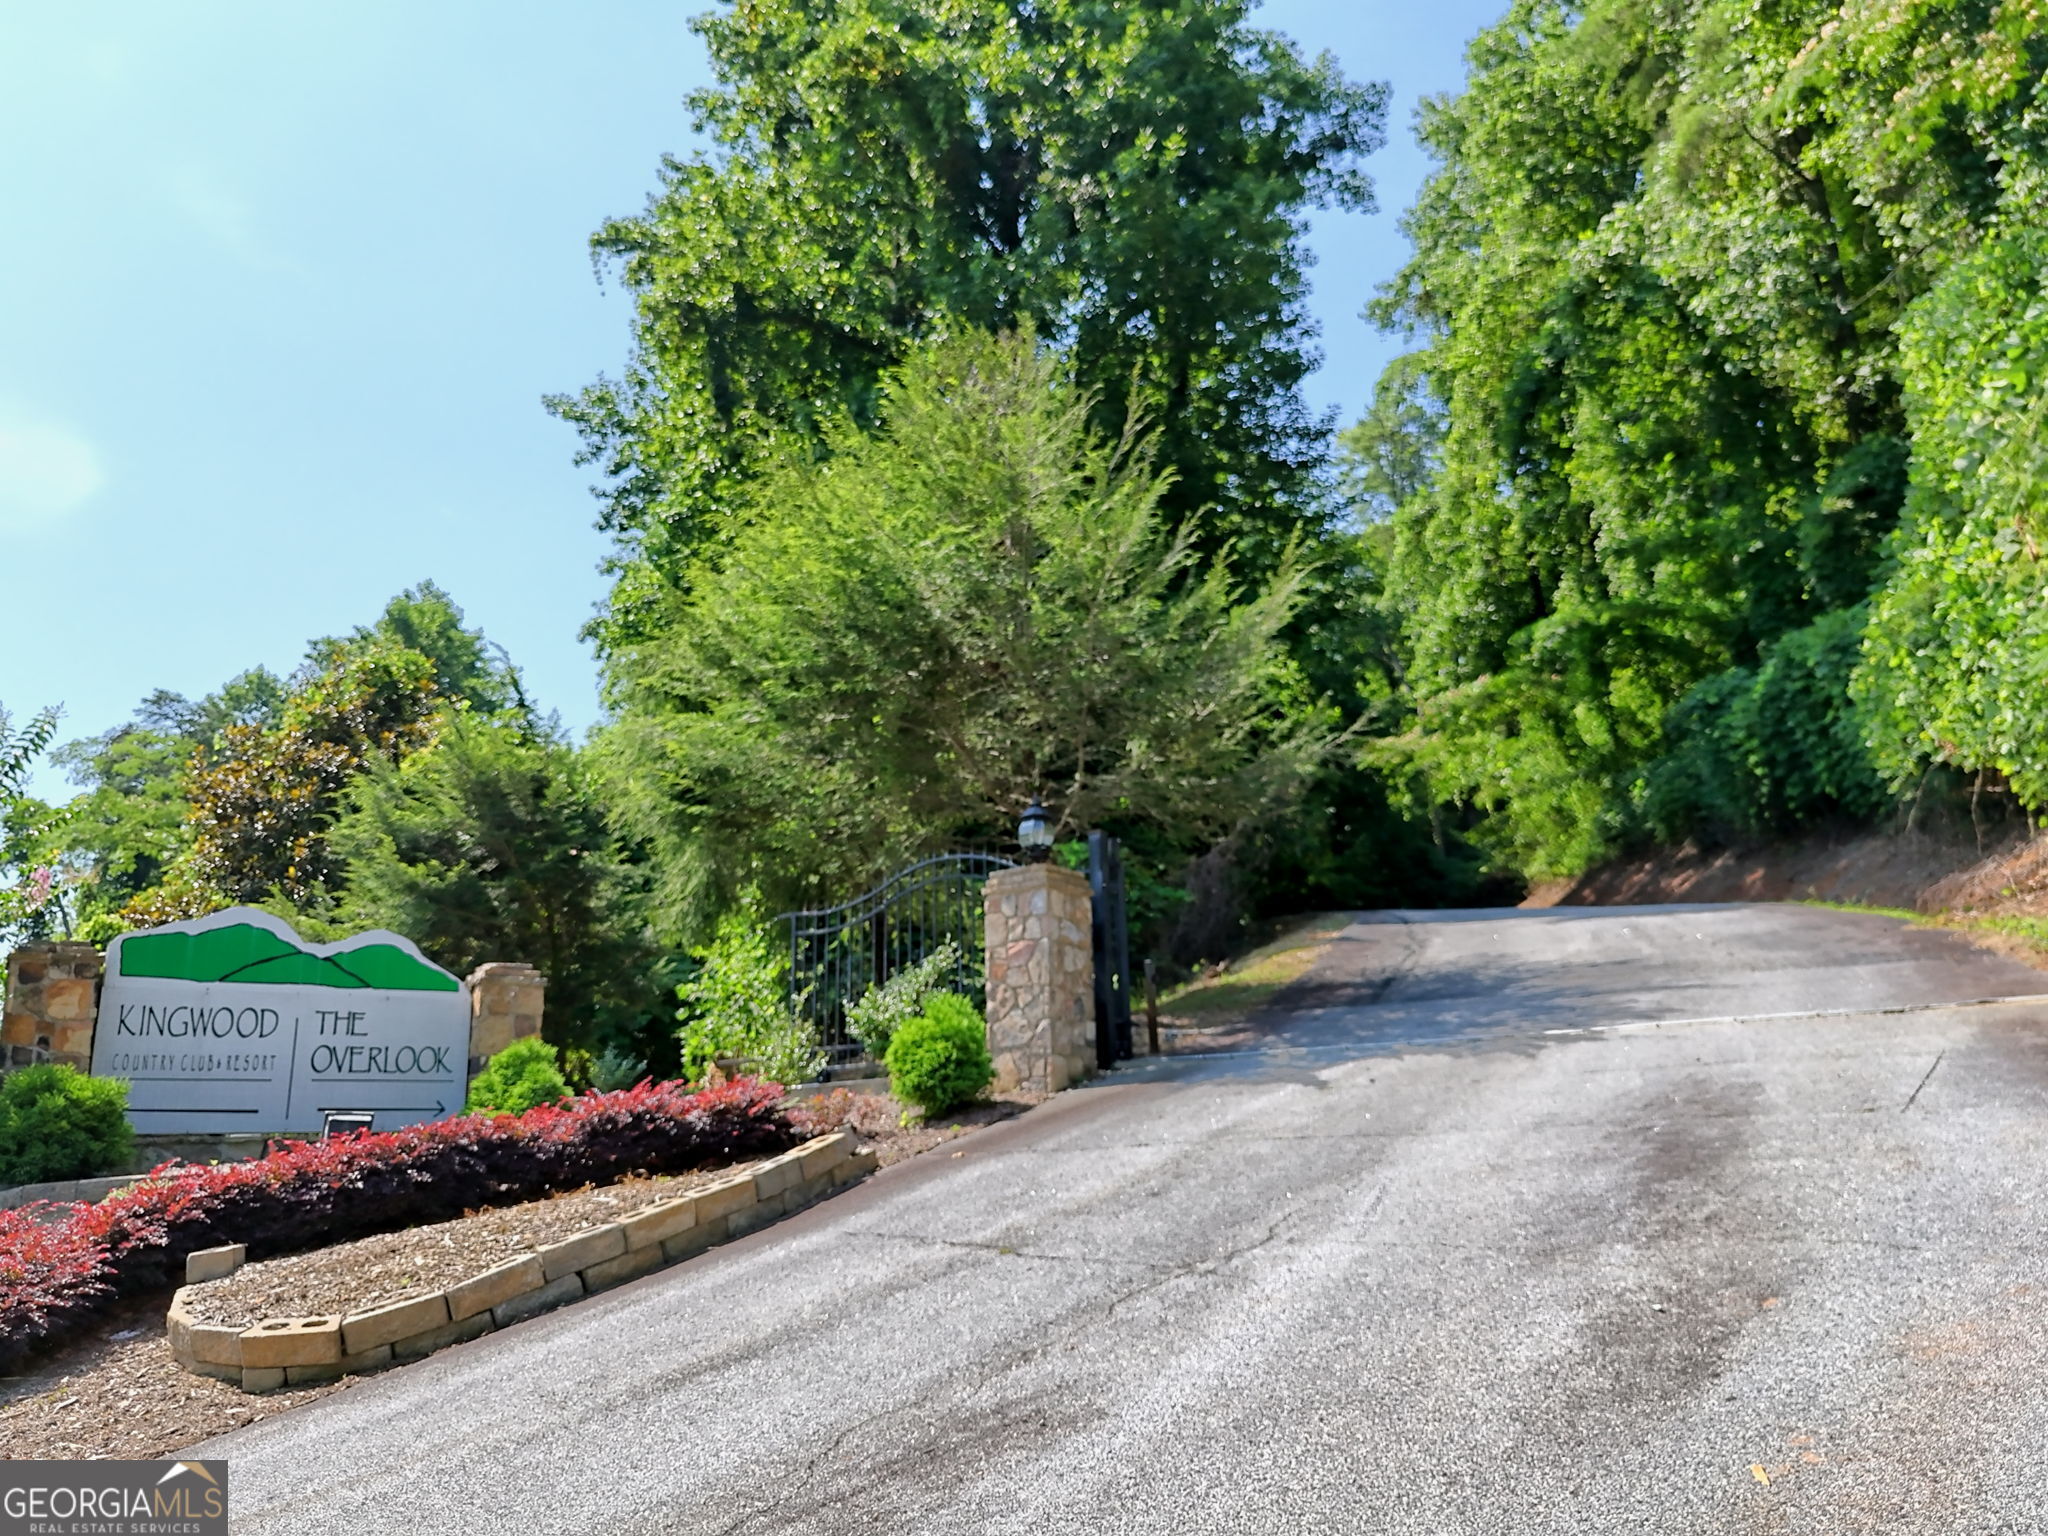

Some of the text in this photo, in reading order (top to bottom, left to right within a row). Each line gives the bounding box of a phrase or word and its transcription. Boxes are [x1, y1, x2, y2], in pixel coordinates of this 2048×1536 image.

[117, 1004, 279, 1038] KINGWOOD
[315, 1010, 368, 1037] THE
[112, 1053, 174, 1072] COUNTRY
[225, 1054, 277, 1073] RESORT
[310, 1045, 453, 1074] OVERLOOK
